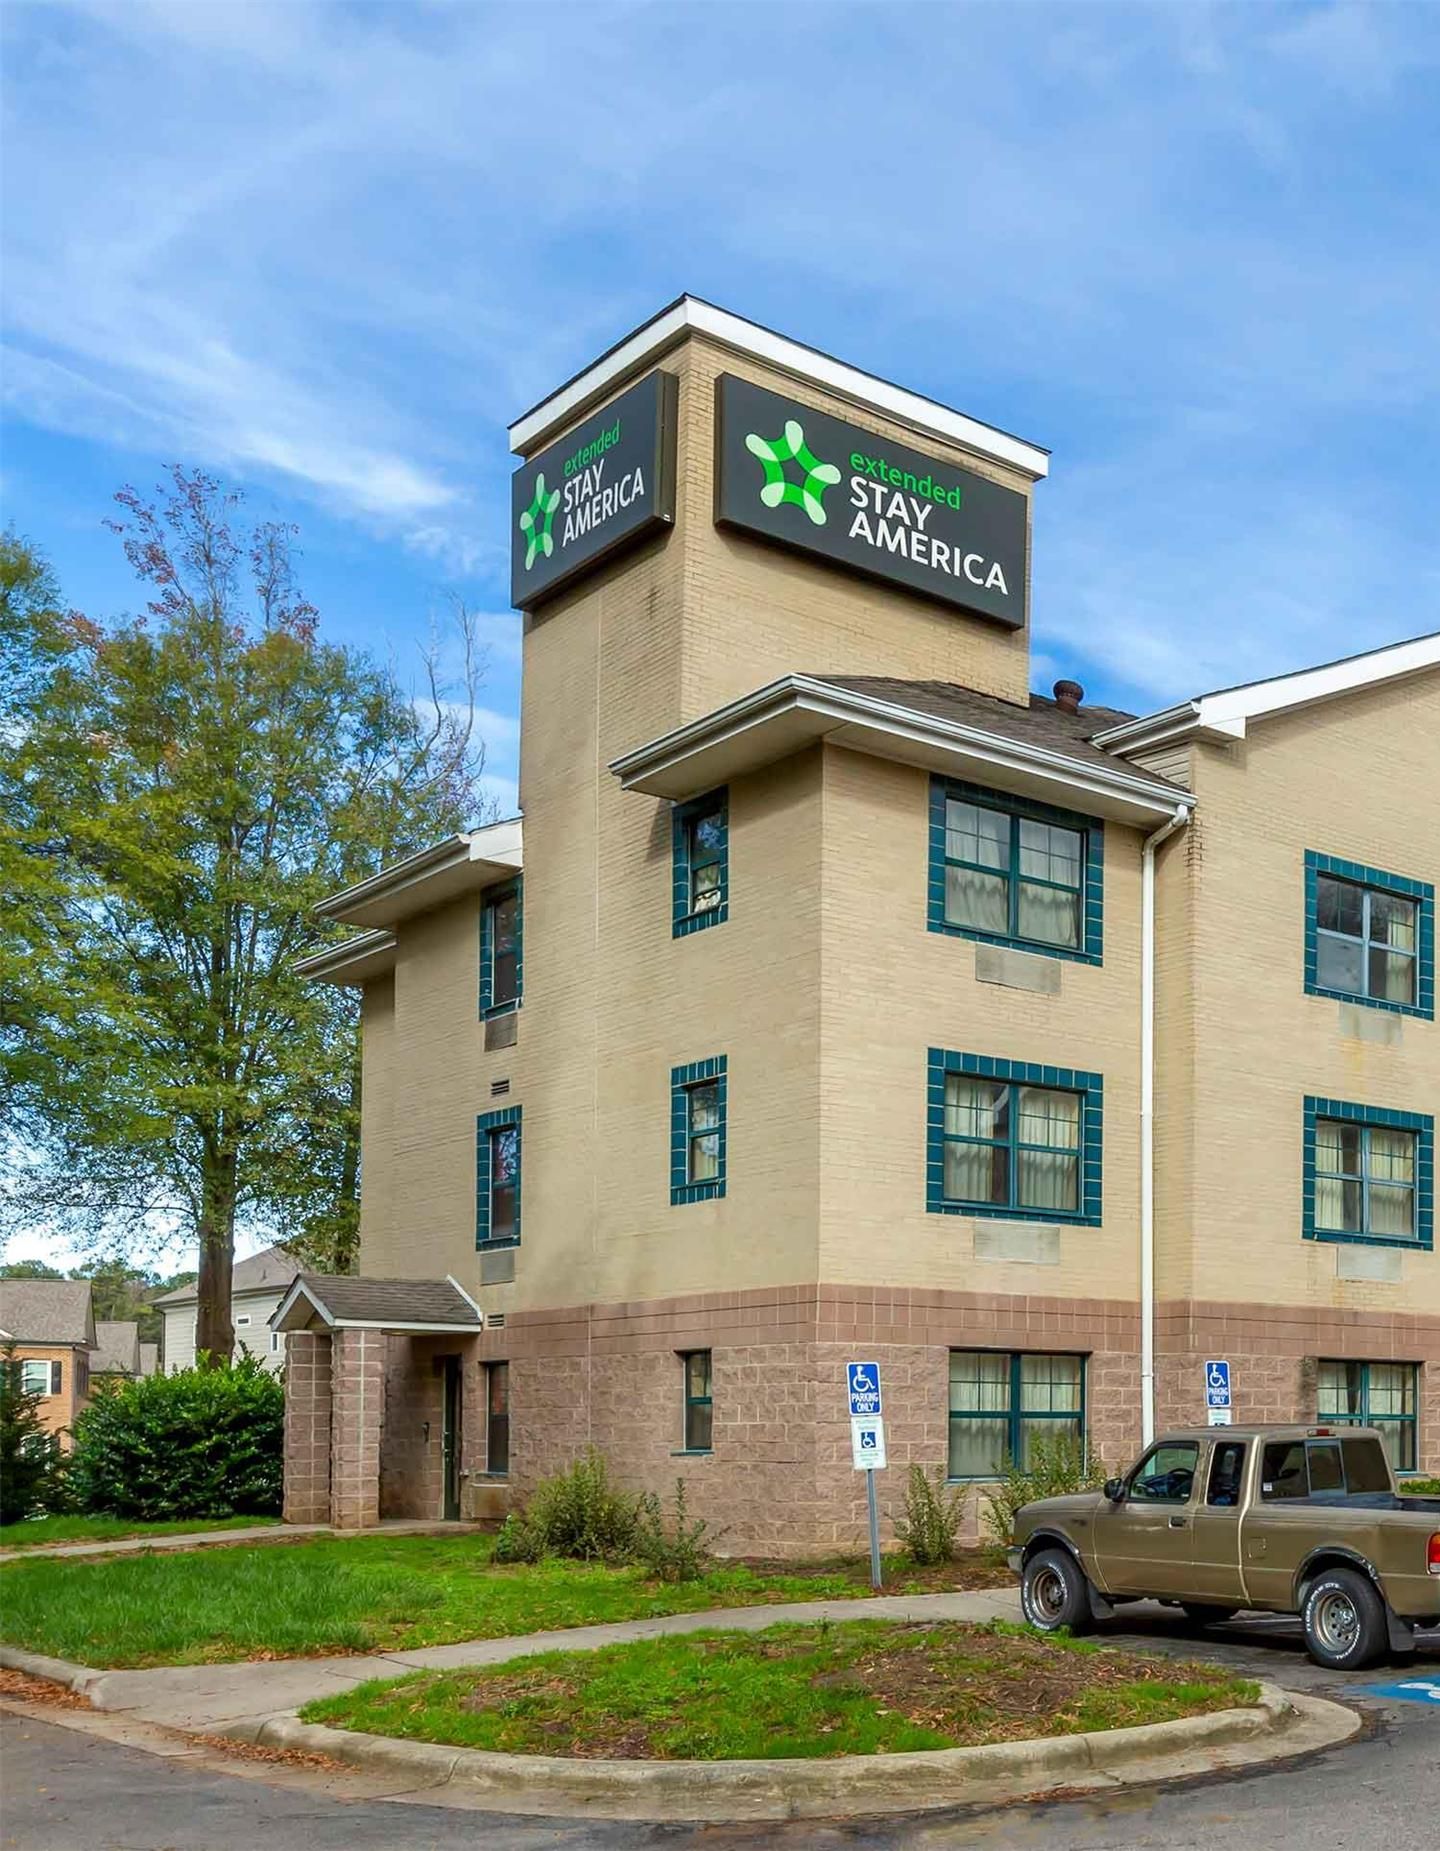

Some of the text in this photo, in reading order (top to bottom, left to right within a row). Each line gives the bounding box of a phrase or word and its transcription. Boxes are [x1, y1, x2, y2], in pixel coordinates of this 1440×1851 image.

[562, 418, 621, 477] extended
[561, 466, 645, 548] AMERICA
[563, 457, 605, 513] STAY
[849, 475, 933, 531] STAY
[850, 452, 960, 510] extended
[848, 510, 1009, 596] AMERICA
[851, 1392, 879, 1403] PARKING
[856, 1402, 875, 1412] ONLY
